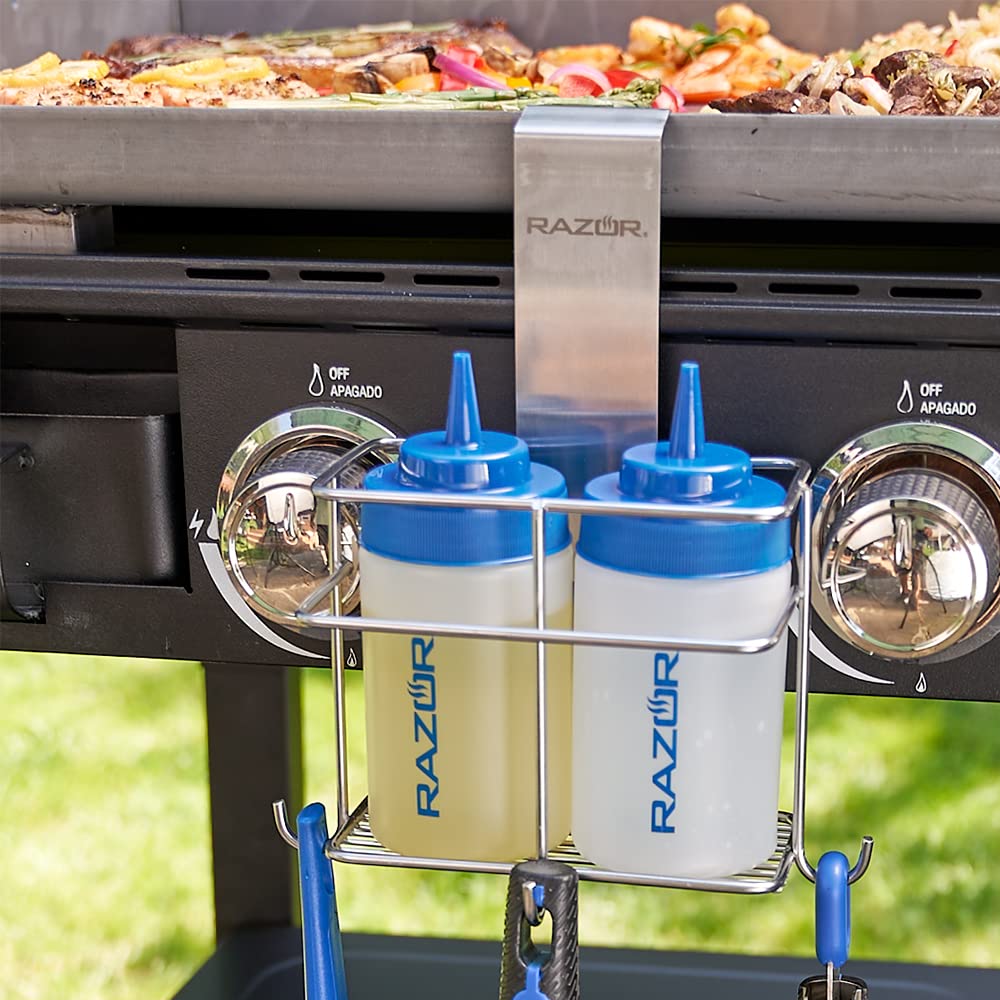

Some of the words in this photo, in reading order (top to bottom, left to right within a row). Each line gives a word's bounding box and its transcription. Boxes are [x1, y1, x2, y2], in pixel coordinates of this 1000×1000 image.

[328, 366, 350, 380] OFF
[330, 384, 383, 398] APAGADO
[920, 383, 943, 397] OFF
[920, 401, 977, 416] APAGADO
[406, 635, 440, 818] RAZOR
[646, 650, 681, 834] RAZOR
